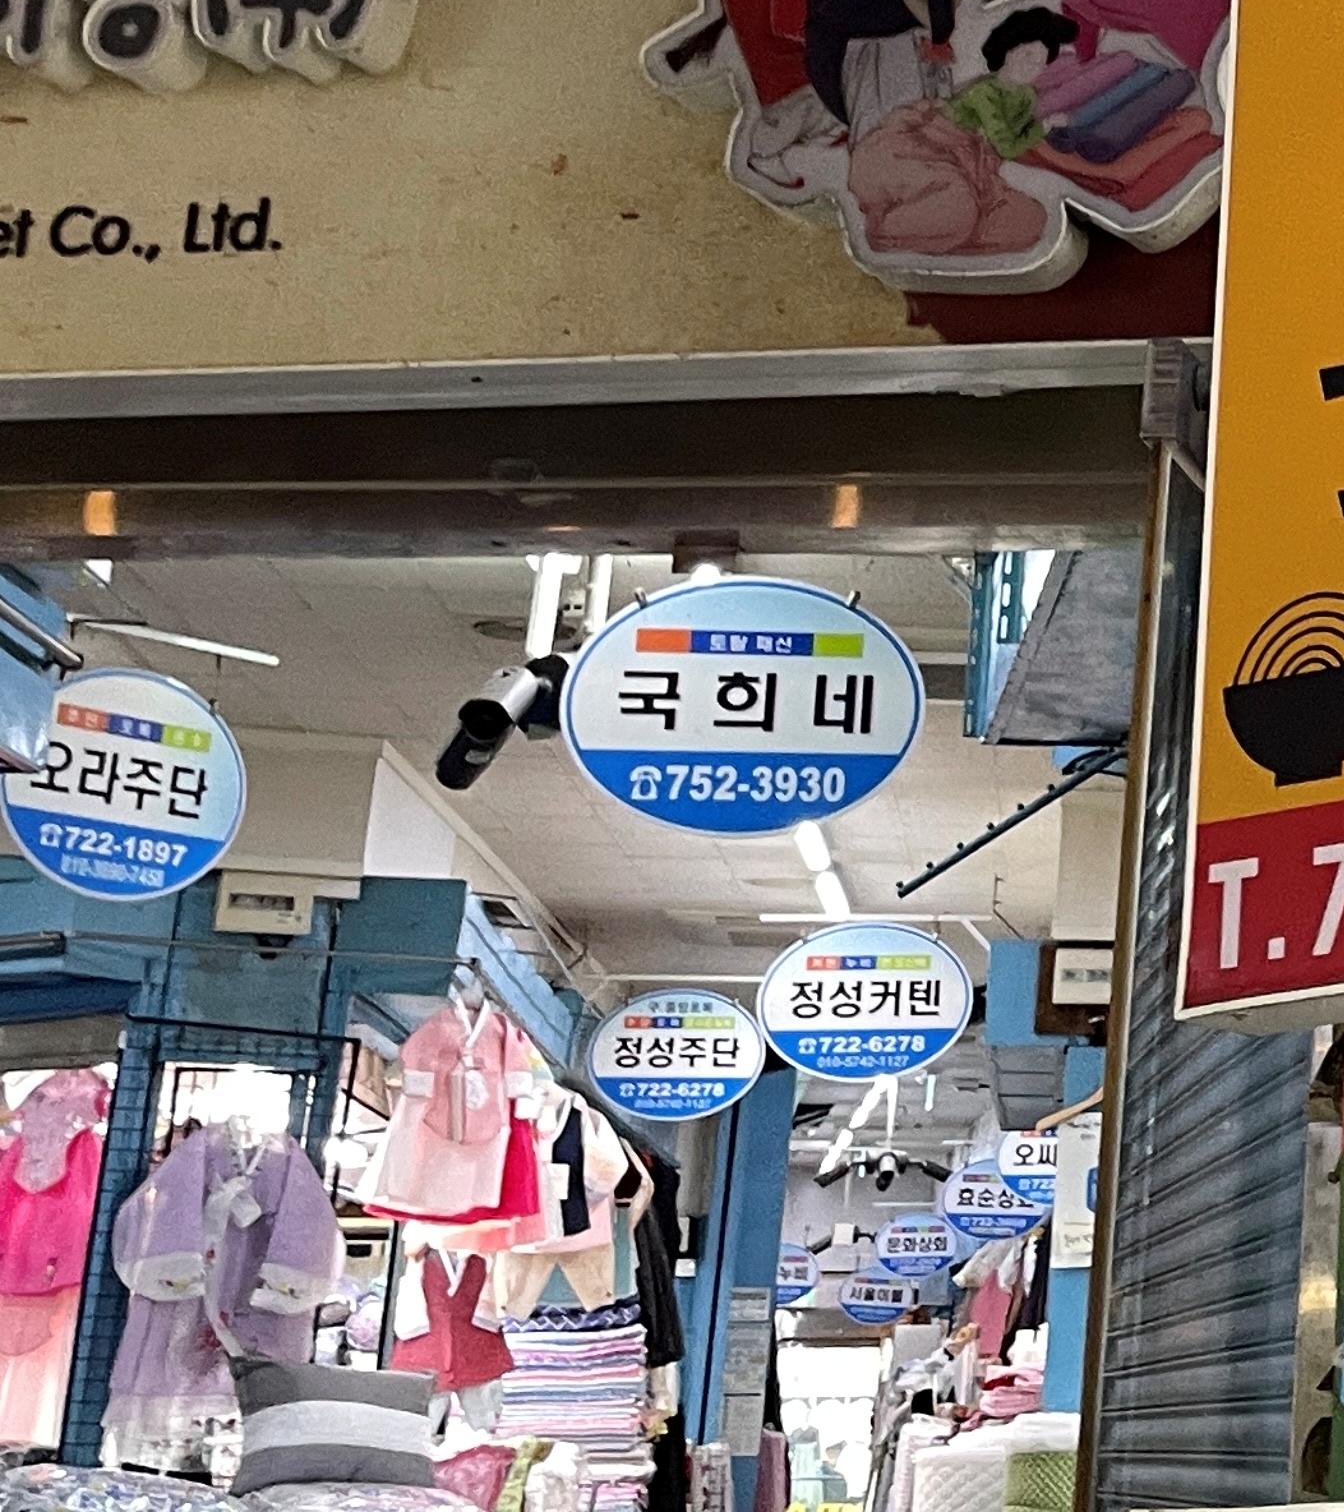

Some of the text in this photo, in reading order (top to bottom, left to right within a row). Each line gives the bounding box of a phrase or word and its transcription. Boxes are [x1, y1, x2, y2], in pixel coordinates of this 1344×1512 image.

[50, 204, 162, 263] Co.,
[182, 196, 283, 253] Ltd.
[618, 670, 875, 734] 국희네
[30, 740, 208, 820] 오라주단
[665, 764, 846, 803] 752-3930
[64, 825, 189, 868] 722-1897
[790, 979, 941, 1019] 정성커텐
[614, 1037, 740, 1069] 정성주단
[819, 1035, 926, 1055] 722-6278
